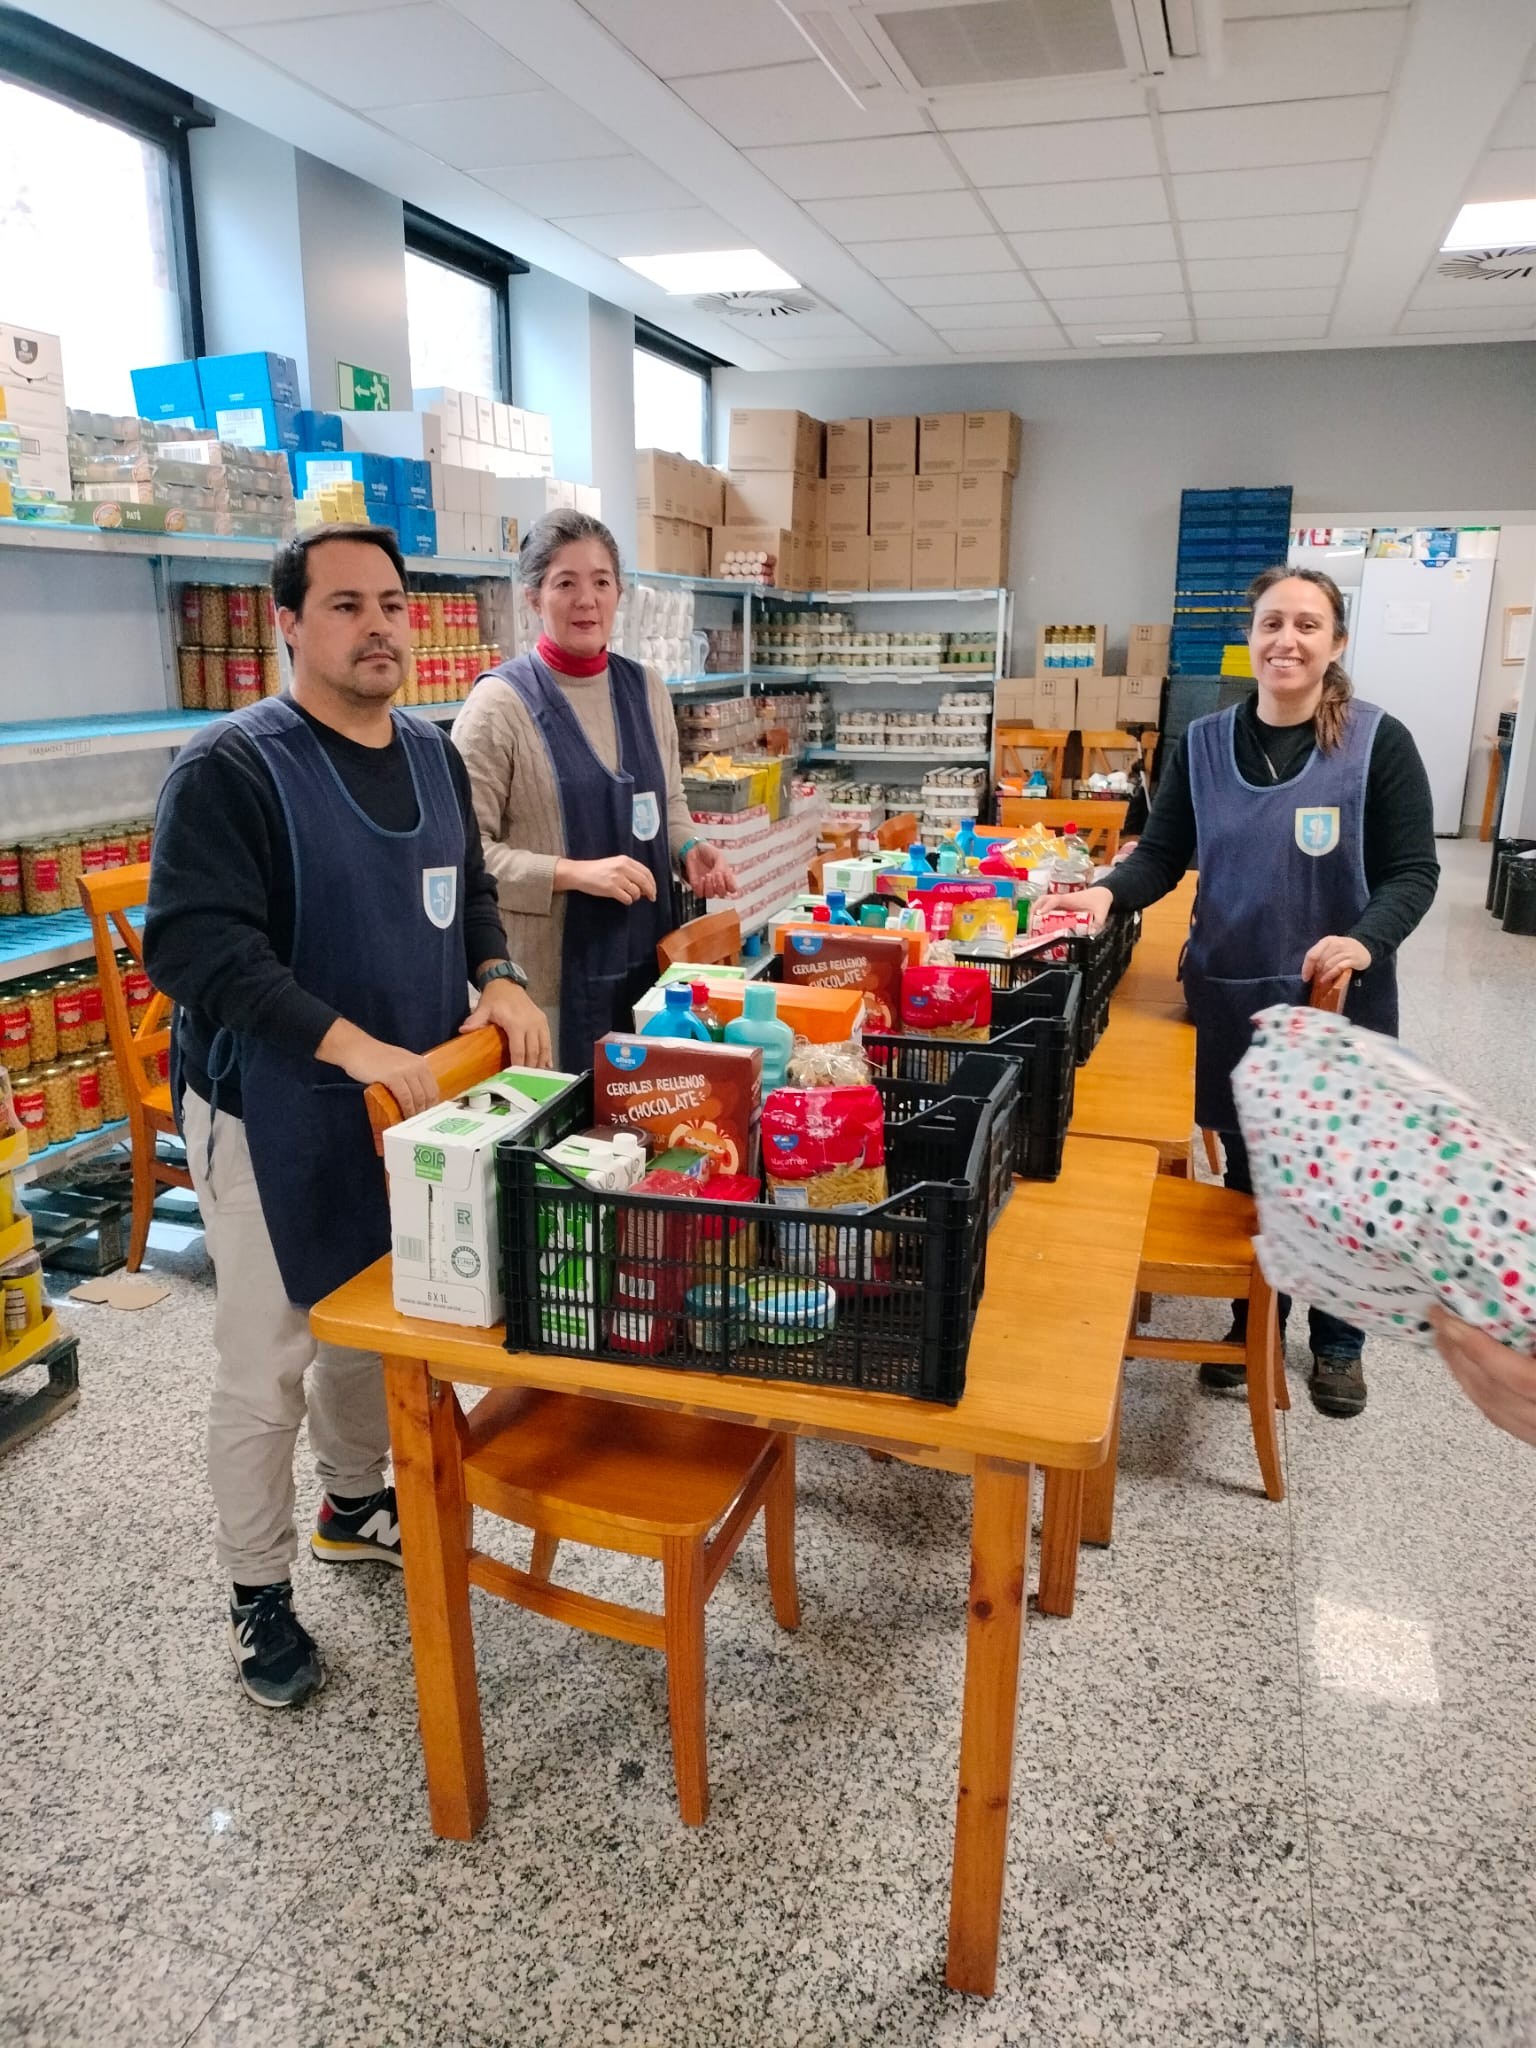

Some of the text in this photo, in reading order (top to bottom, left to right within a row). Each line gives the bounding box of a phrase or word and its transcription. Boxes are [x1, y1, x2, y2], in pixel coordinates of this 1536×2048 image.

[606, 1074, 705, 1097] CEREALES RELLENOS
[619, 1090, 700, 1124] DE CHOCOLATE
